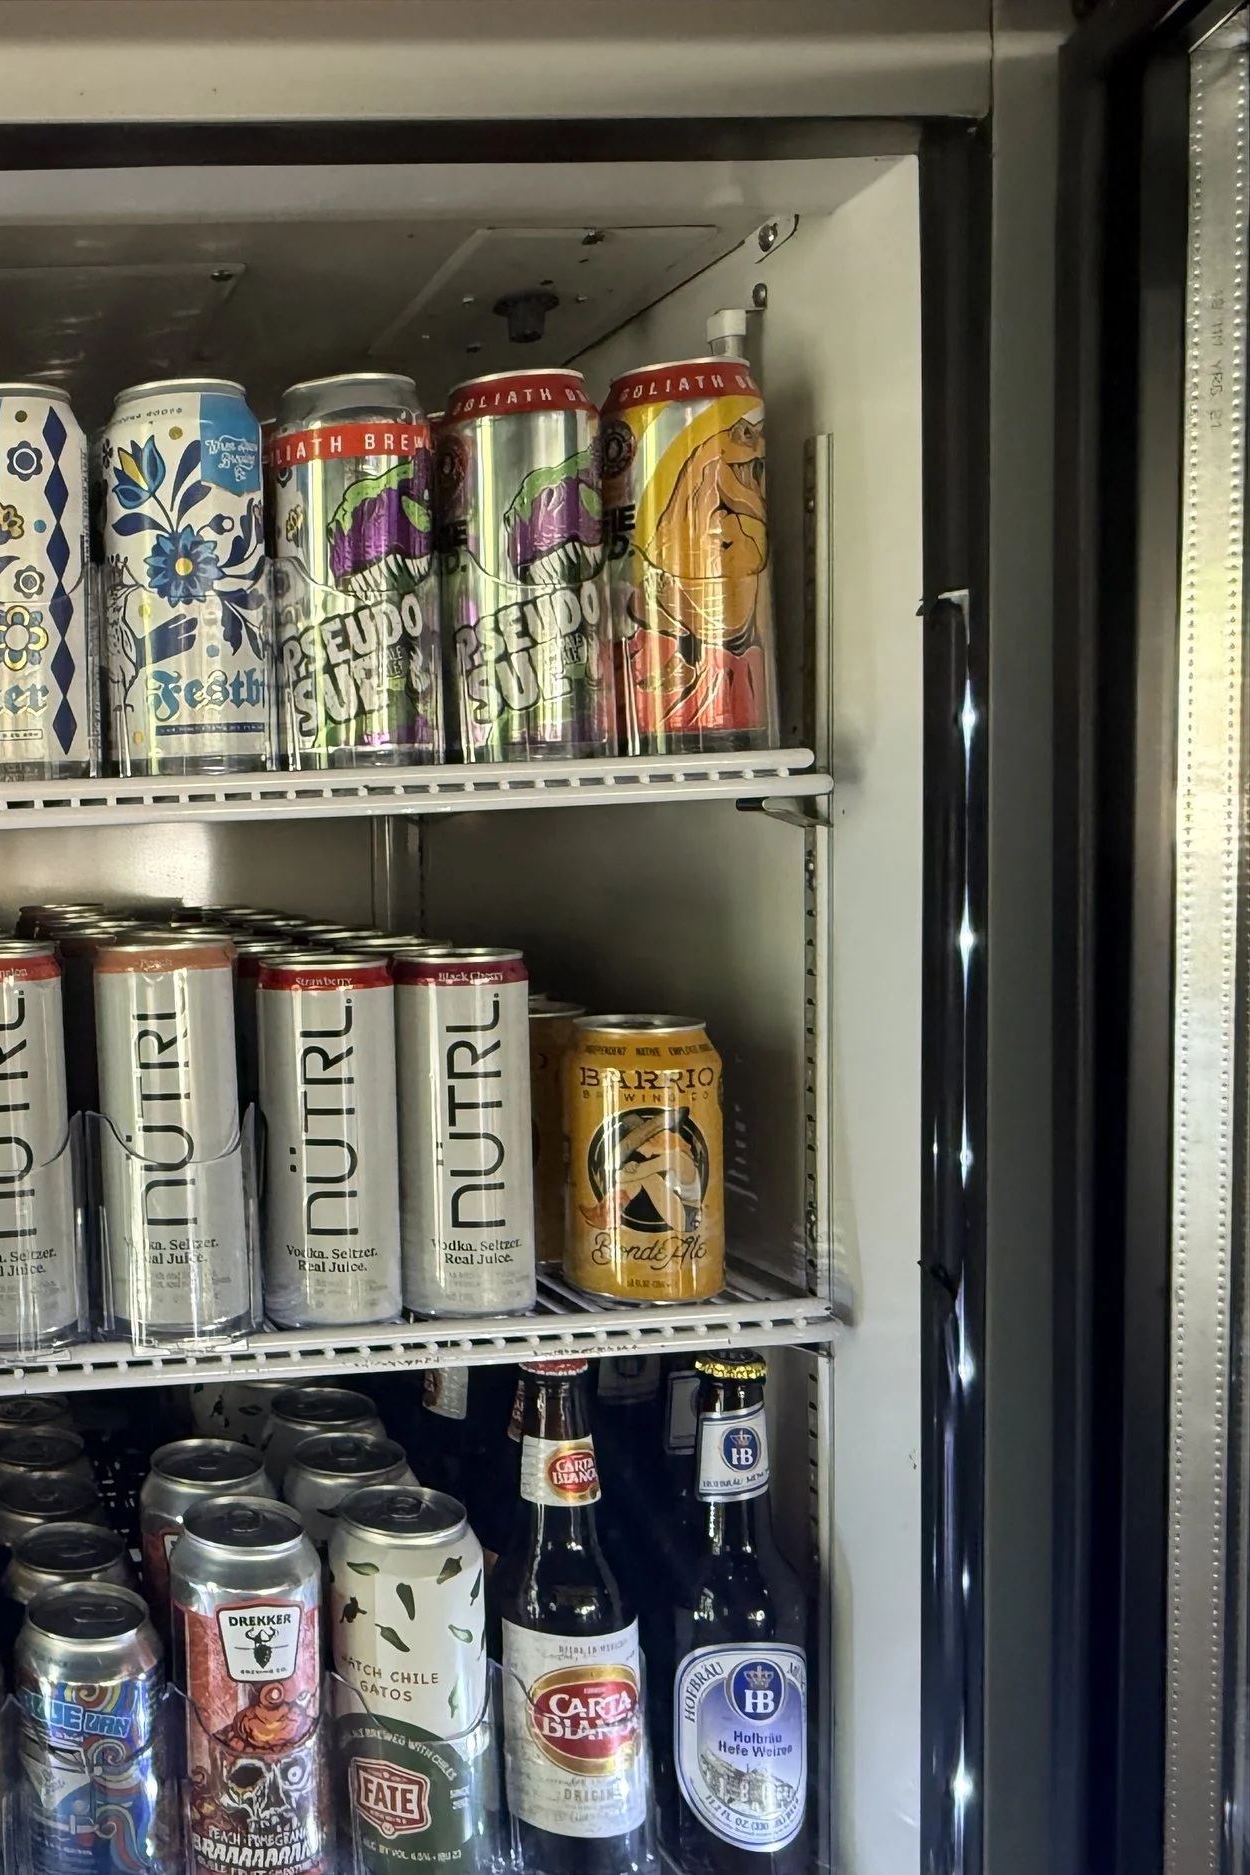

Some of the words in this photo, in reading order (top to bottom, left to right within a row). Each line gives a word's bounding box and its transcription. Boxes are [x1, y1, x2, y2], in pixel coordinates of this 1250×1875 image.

[456, 581, 600, 671] PSEUDO
[282, 593, 423, 686] PSEUDO
[295, 976, 352, 987] Strawberry
[438, 972, 468, 982] Black
[580, 1067, 714, 1093] BARRIO
[583, 1090, 676, 1102] BRWING
[480, 1238, 523, 1251] Seltzer.
[10, 1248, 57, 1261] Seltzer.
[167, 1252, 208, 1265] Juice.
[286, 1245, 329, 1260] Vodka.
[332, 1247, 378, 1259] Seltzer.
[445, 1252, 474, 1265] Real
[477, 1252, 513, 1266] Juice.
[7, 1263, 46, 1277] Juice.
[299, 1260, 326, 1272] Real
[329, 1261, 368, 1273] Juice.
[731, 1447, 754, 1465] HB
[555, 1456, 595, 1472] CARTA
[228, 1614, 291, 1627] DREKKER
[390, 1671, 439, 1685] CHILE
[360, 1680, 412, 1702] GATOS
[684, 1659, 725, 1723] HOFBRÄU
[548, 1690, 632, 1722] CARTA
[744, 1689, 775, 1714] HB
[733, 1730, 783, 1744] Hofbräu
[718, 1740, 749, 1757] Hefe
[362, 1776, 414, 1815] FATE
[564, 1787, 618, 1803] ORIGIN
[209, 1825, 241, 1845] PEACH
